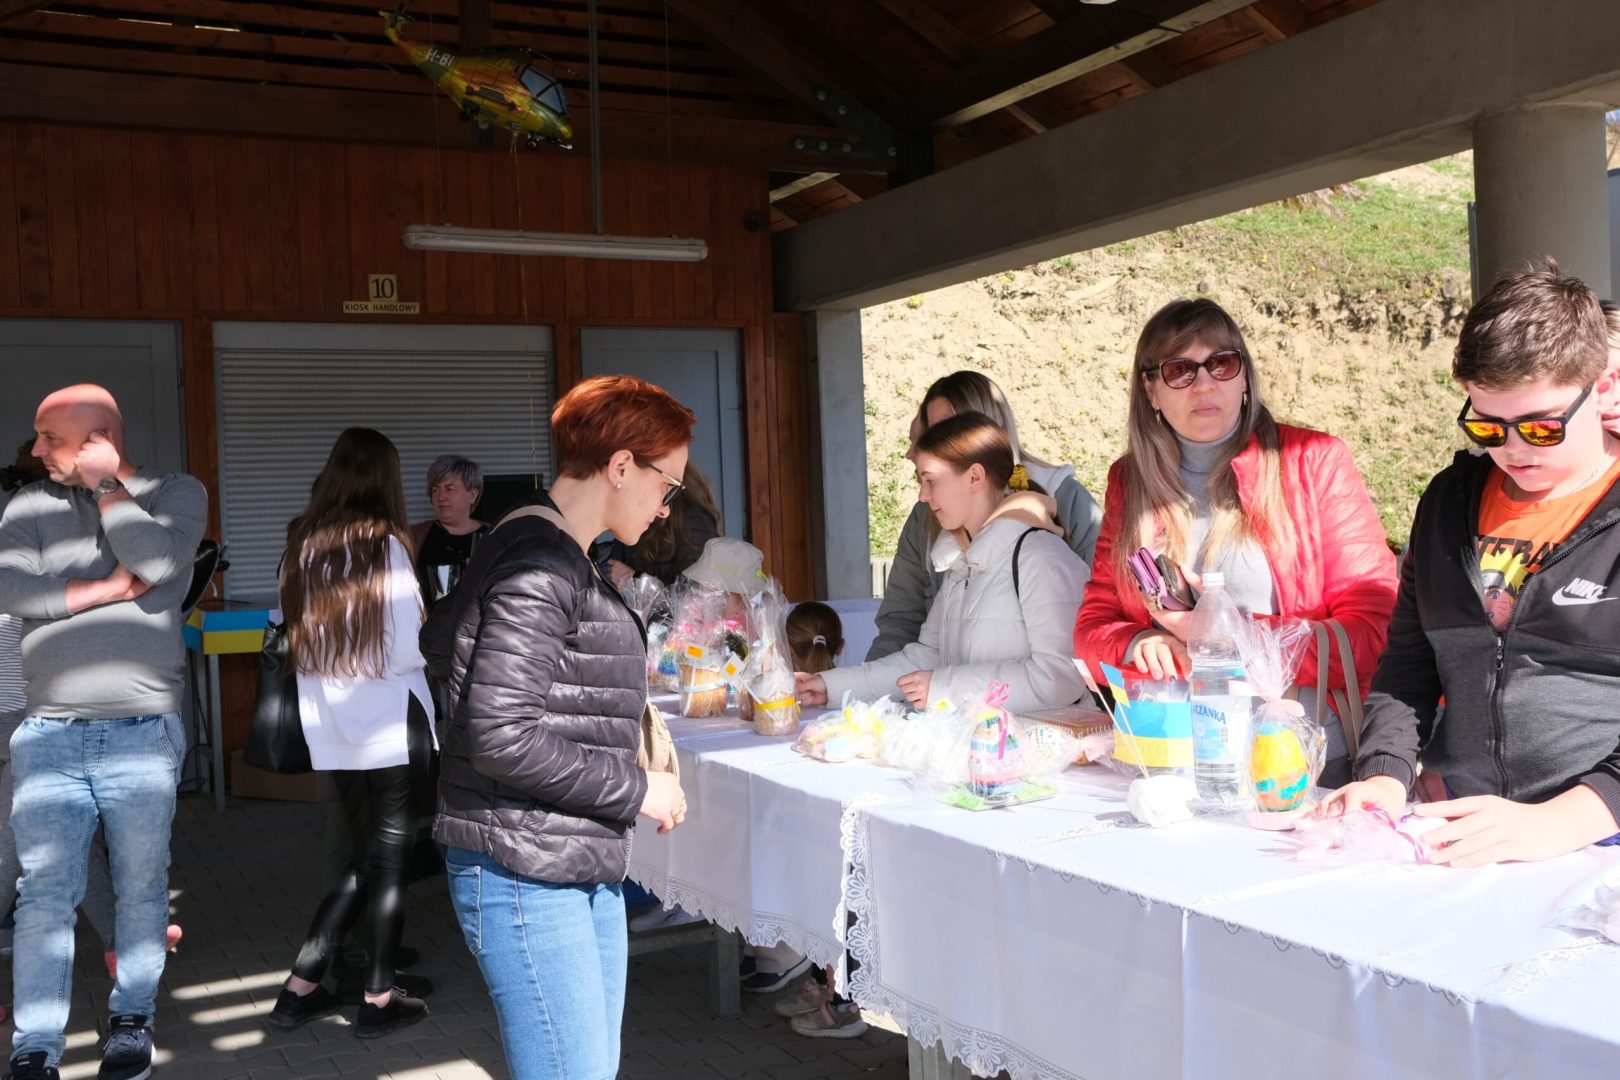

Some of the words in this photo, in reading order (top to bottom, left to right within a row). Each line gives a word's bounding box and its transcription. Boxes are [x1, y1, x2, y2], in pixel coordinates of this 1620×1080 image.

[371, 278, 395, 299] 10
[345, 303, 370, 312] KIOSK
[373, 304, 418, 313] HANDLOWY
[1566, 577, 1608, 600] NIKE
